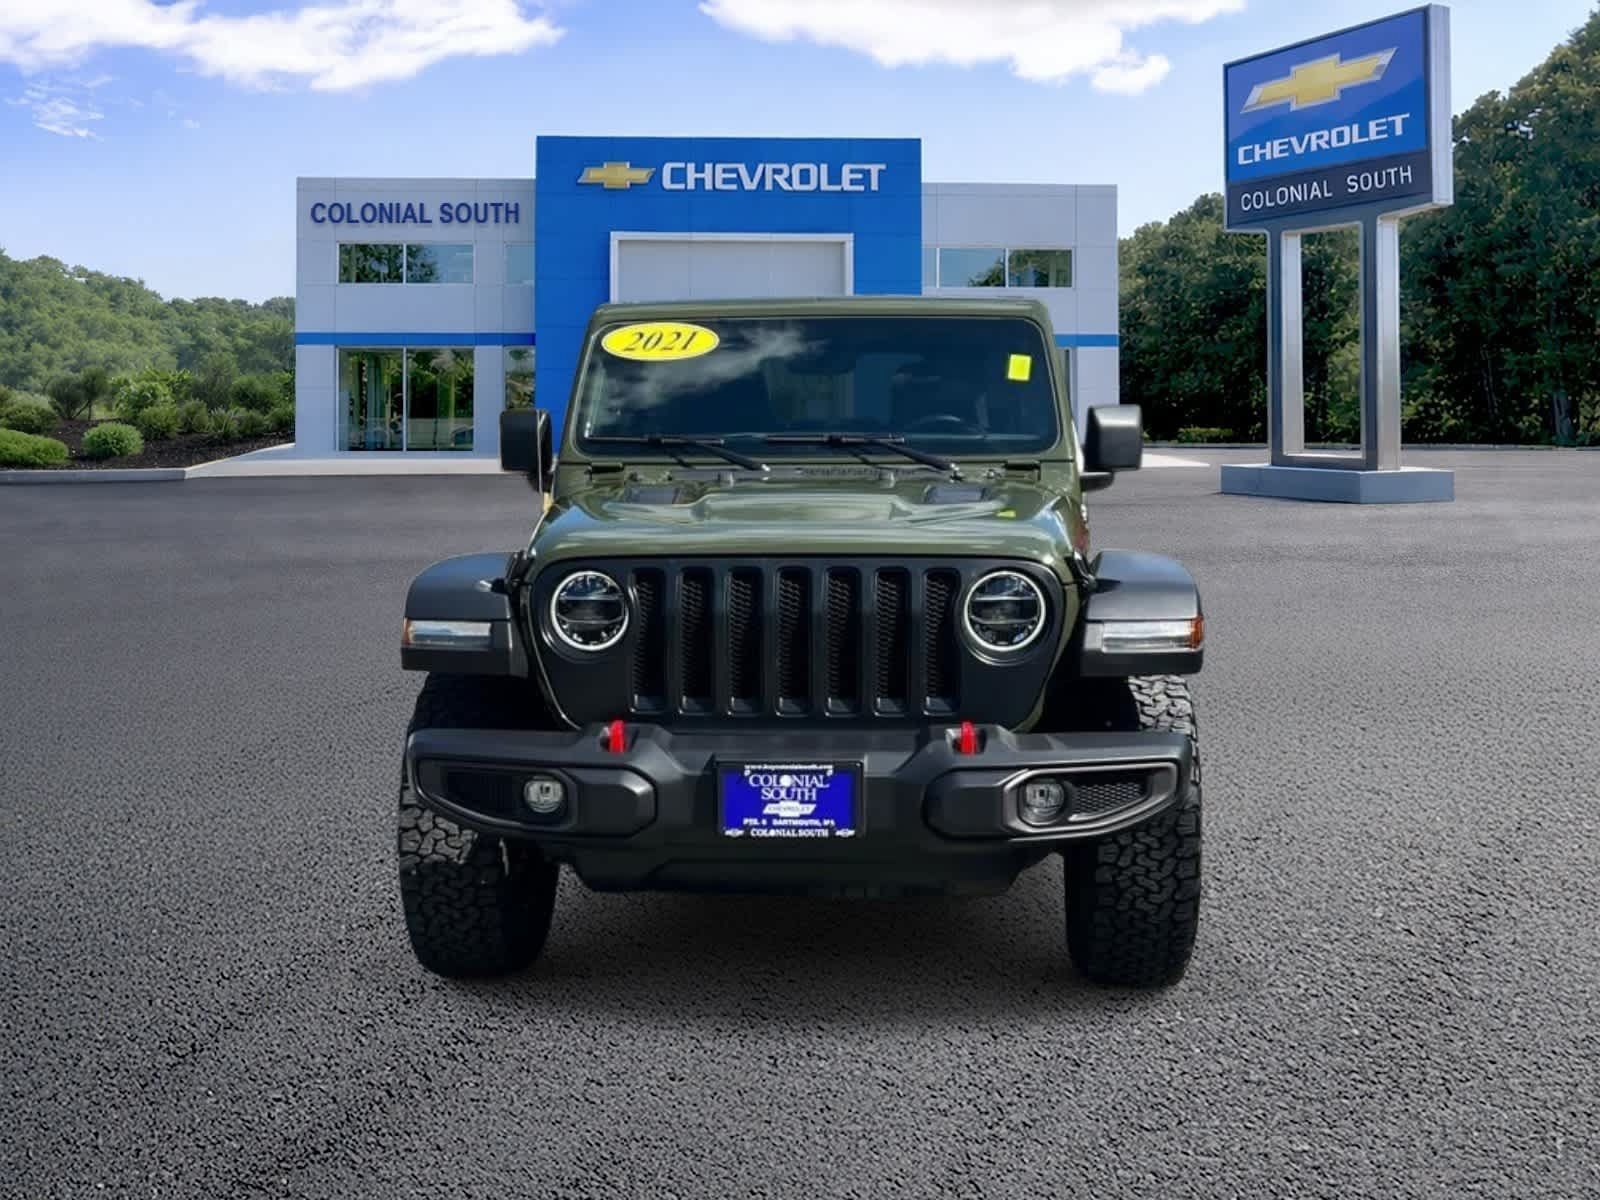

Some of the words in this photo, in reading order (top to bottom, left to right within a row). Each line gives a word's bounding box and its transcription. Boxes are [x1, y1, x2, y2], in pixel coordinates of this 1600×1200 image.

[1237, 112, 1410, 165] CHEVROLET
[661, 161, 887, 192] CHEVROLET
[1240, 179, 1333, 211] COLONIAL
[1346, 165, 1413, 194] SOUTH
[310, 202, 433, 225] COLONIAL
[439, 202, 520, 225] SOUTH
[622, 331, 698, 352] 2021
[748, 774, 830, 788] COLONIAL
[760, 787, 817, 801] SOUTH
